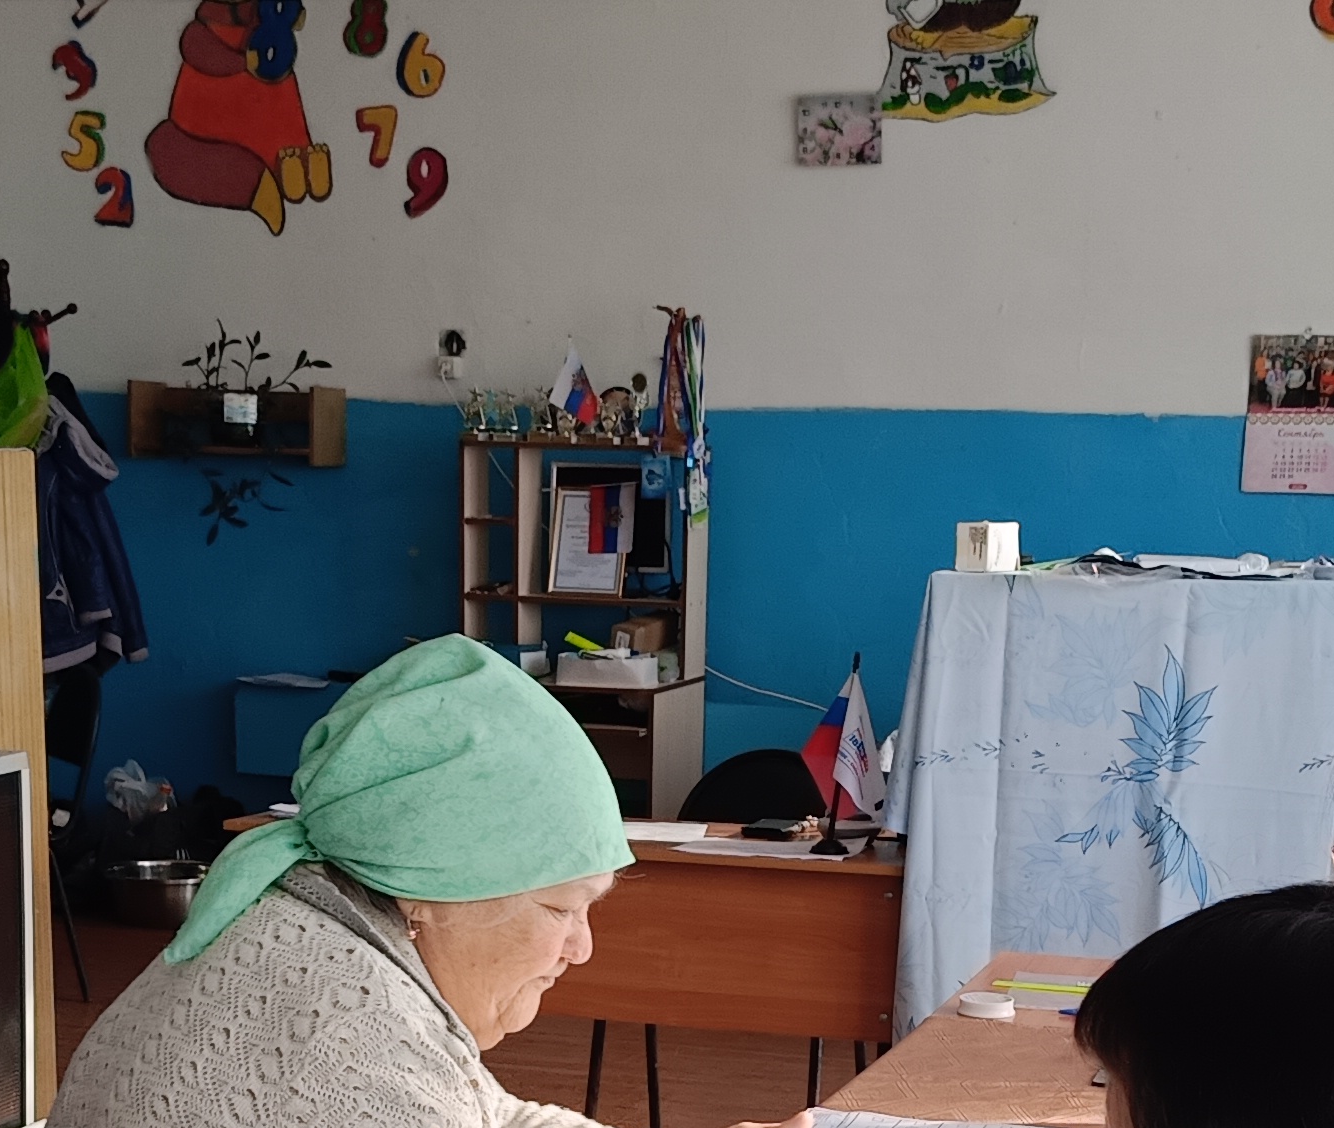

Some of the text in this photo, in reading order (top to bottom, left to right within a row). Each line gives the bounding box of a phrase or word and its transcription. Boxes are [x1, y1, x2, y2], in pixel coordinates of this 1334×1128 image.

[396, 31, 445, 98] 6
[61, 111, 106, 171] 5
[355, 105, 398, 167] 7
[94, 166, 134, 228] 2
[404, 147, 449, 218] 9
